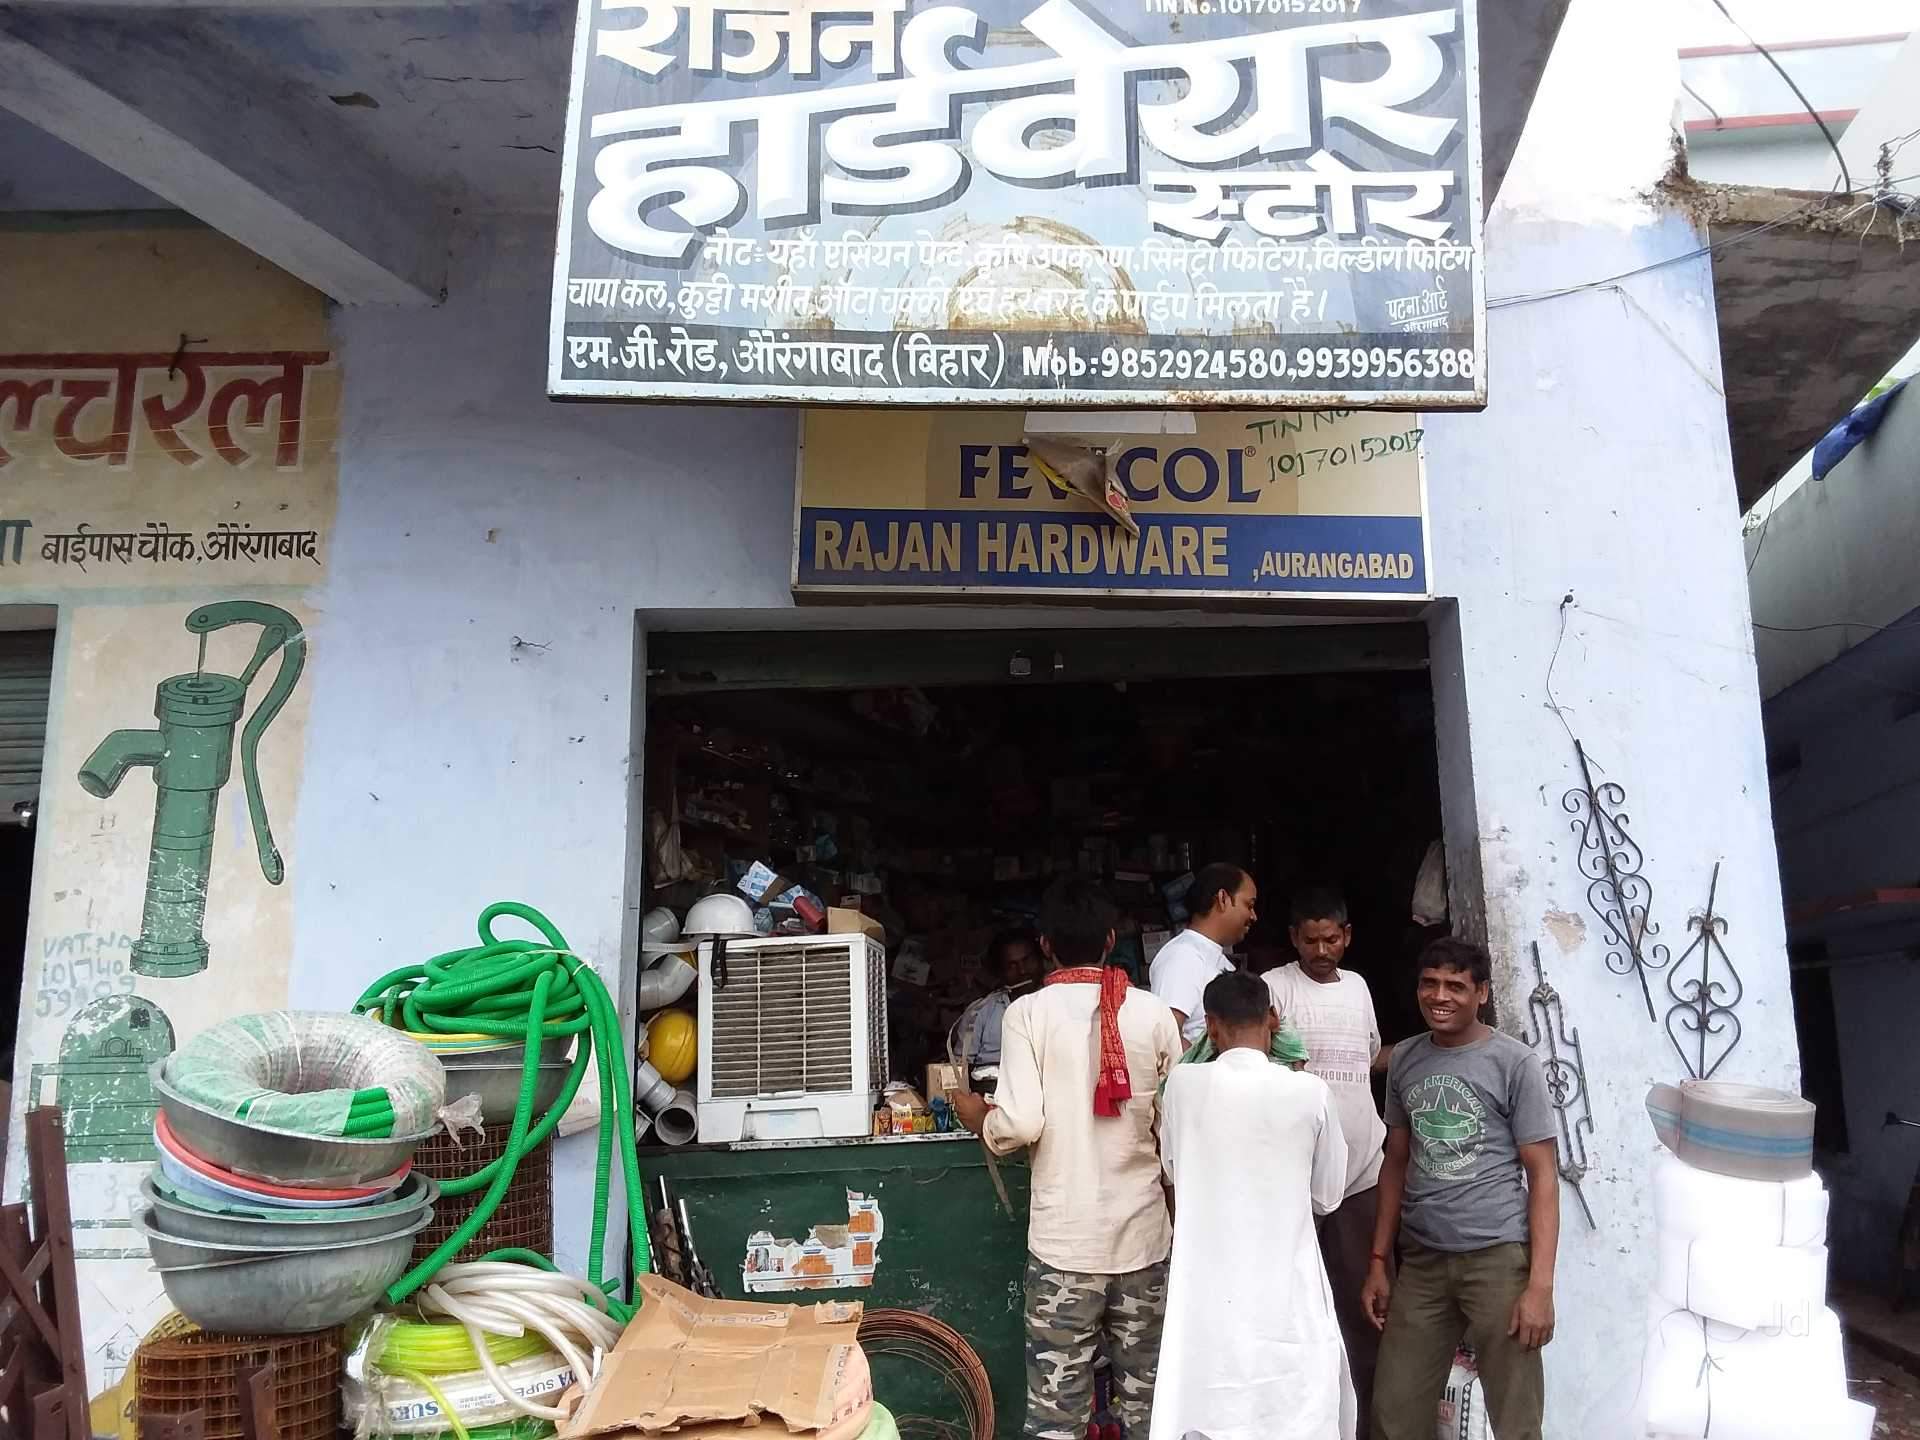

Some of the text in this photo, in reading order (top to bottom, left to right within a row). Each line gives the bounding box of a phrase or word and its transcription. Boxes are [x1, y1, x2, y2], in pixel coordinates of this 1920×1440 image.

[1147, 149, 1455, 240] स्टोर
[732, 329, 886, 384] औरंगाबाद
[1245, 411, 1303, 445] TIN
[958, 443, 1261, 503] FECOL
[813, 519, 960, 573] RAJAN
[977, 521, 1229, 578] HARDWARE
